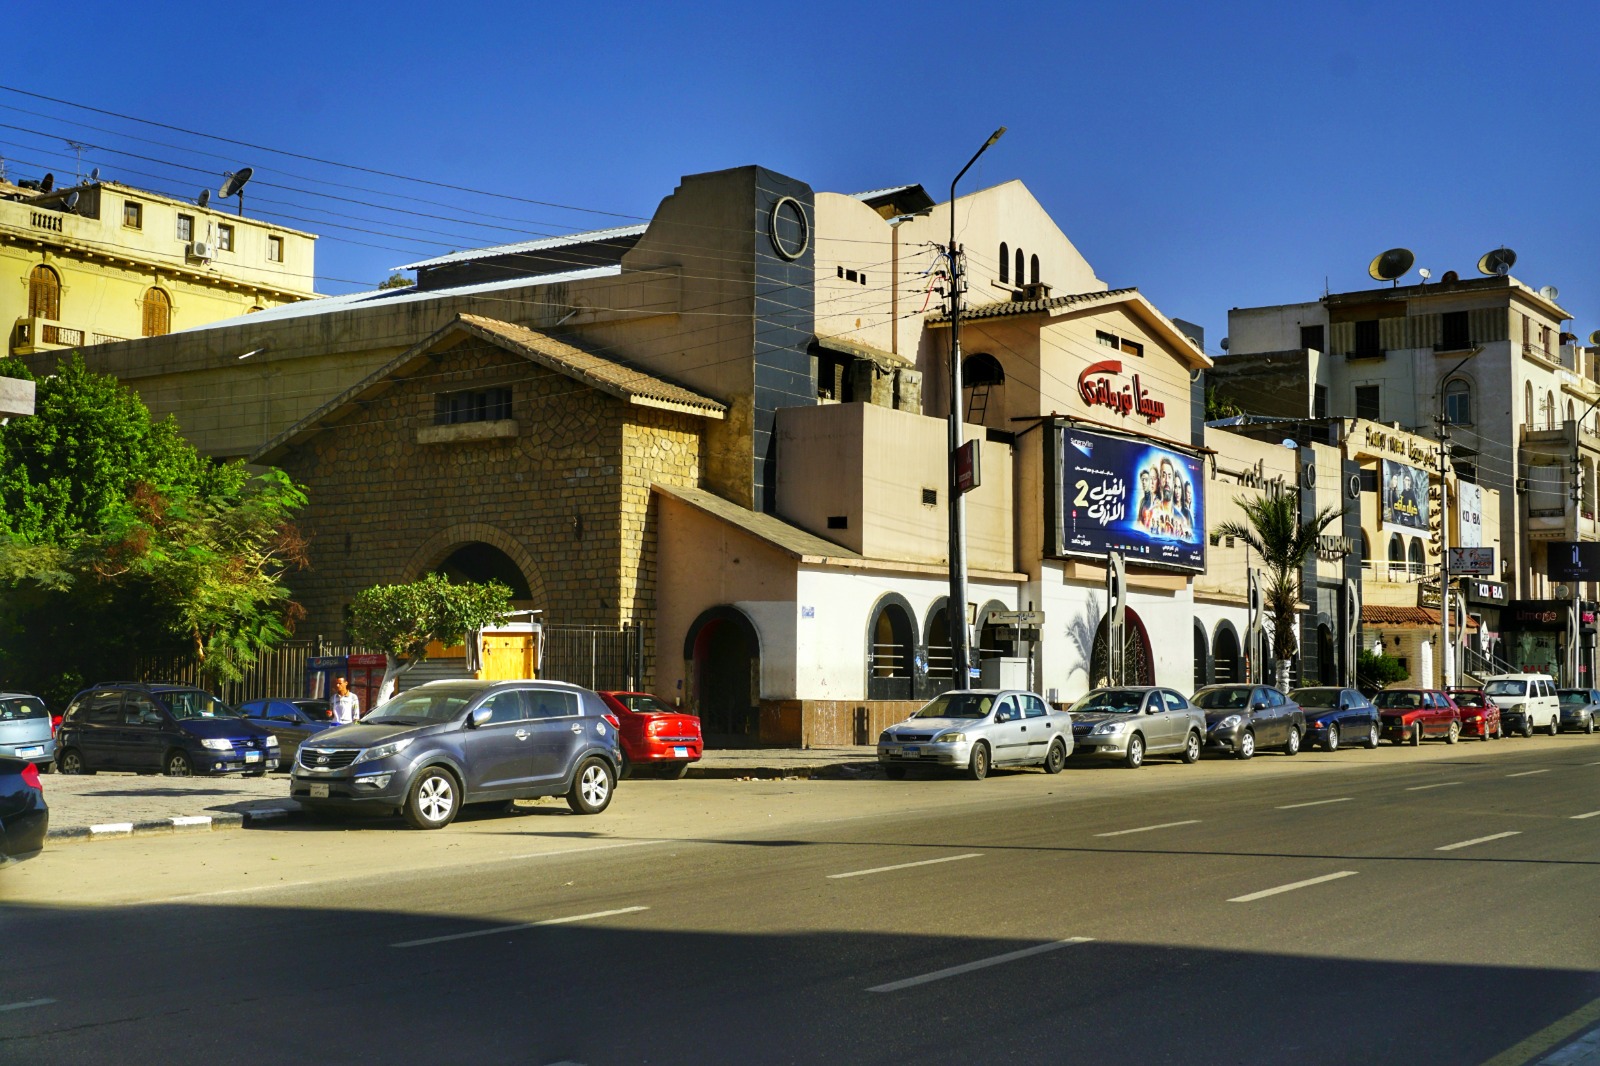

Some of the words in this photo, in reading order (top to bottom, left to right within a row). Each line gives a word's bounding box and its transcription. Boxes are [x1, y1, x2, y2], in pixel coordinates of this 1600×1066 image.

[1132, 373, 1165, 424] سينما
[1073, 479, 1089, 507] 2
[1089, 477, 1126, 501] الفيل
[1087, 497, 1125, 527] الأزرق
[1462, 510, 1481, 525] KOBA
